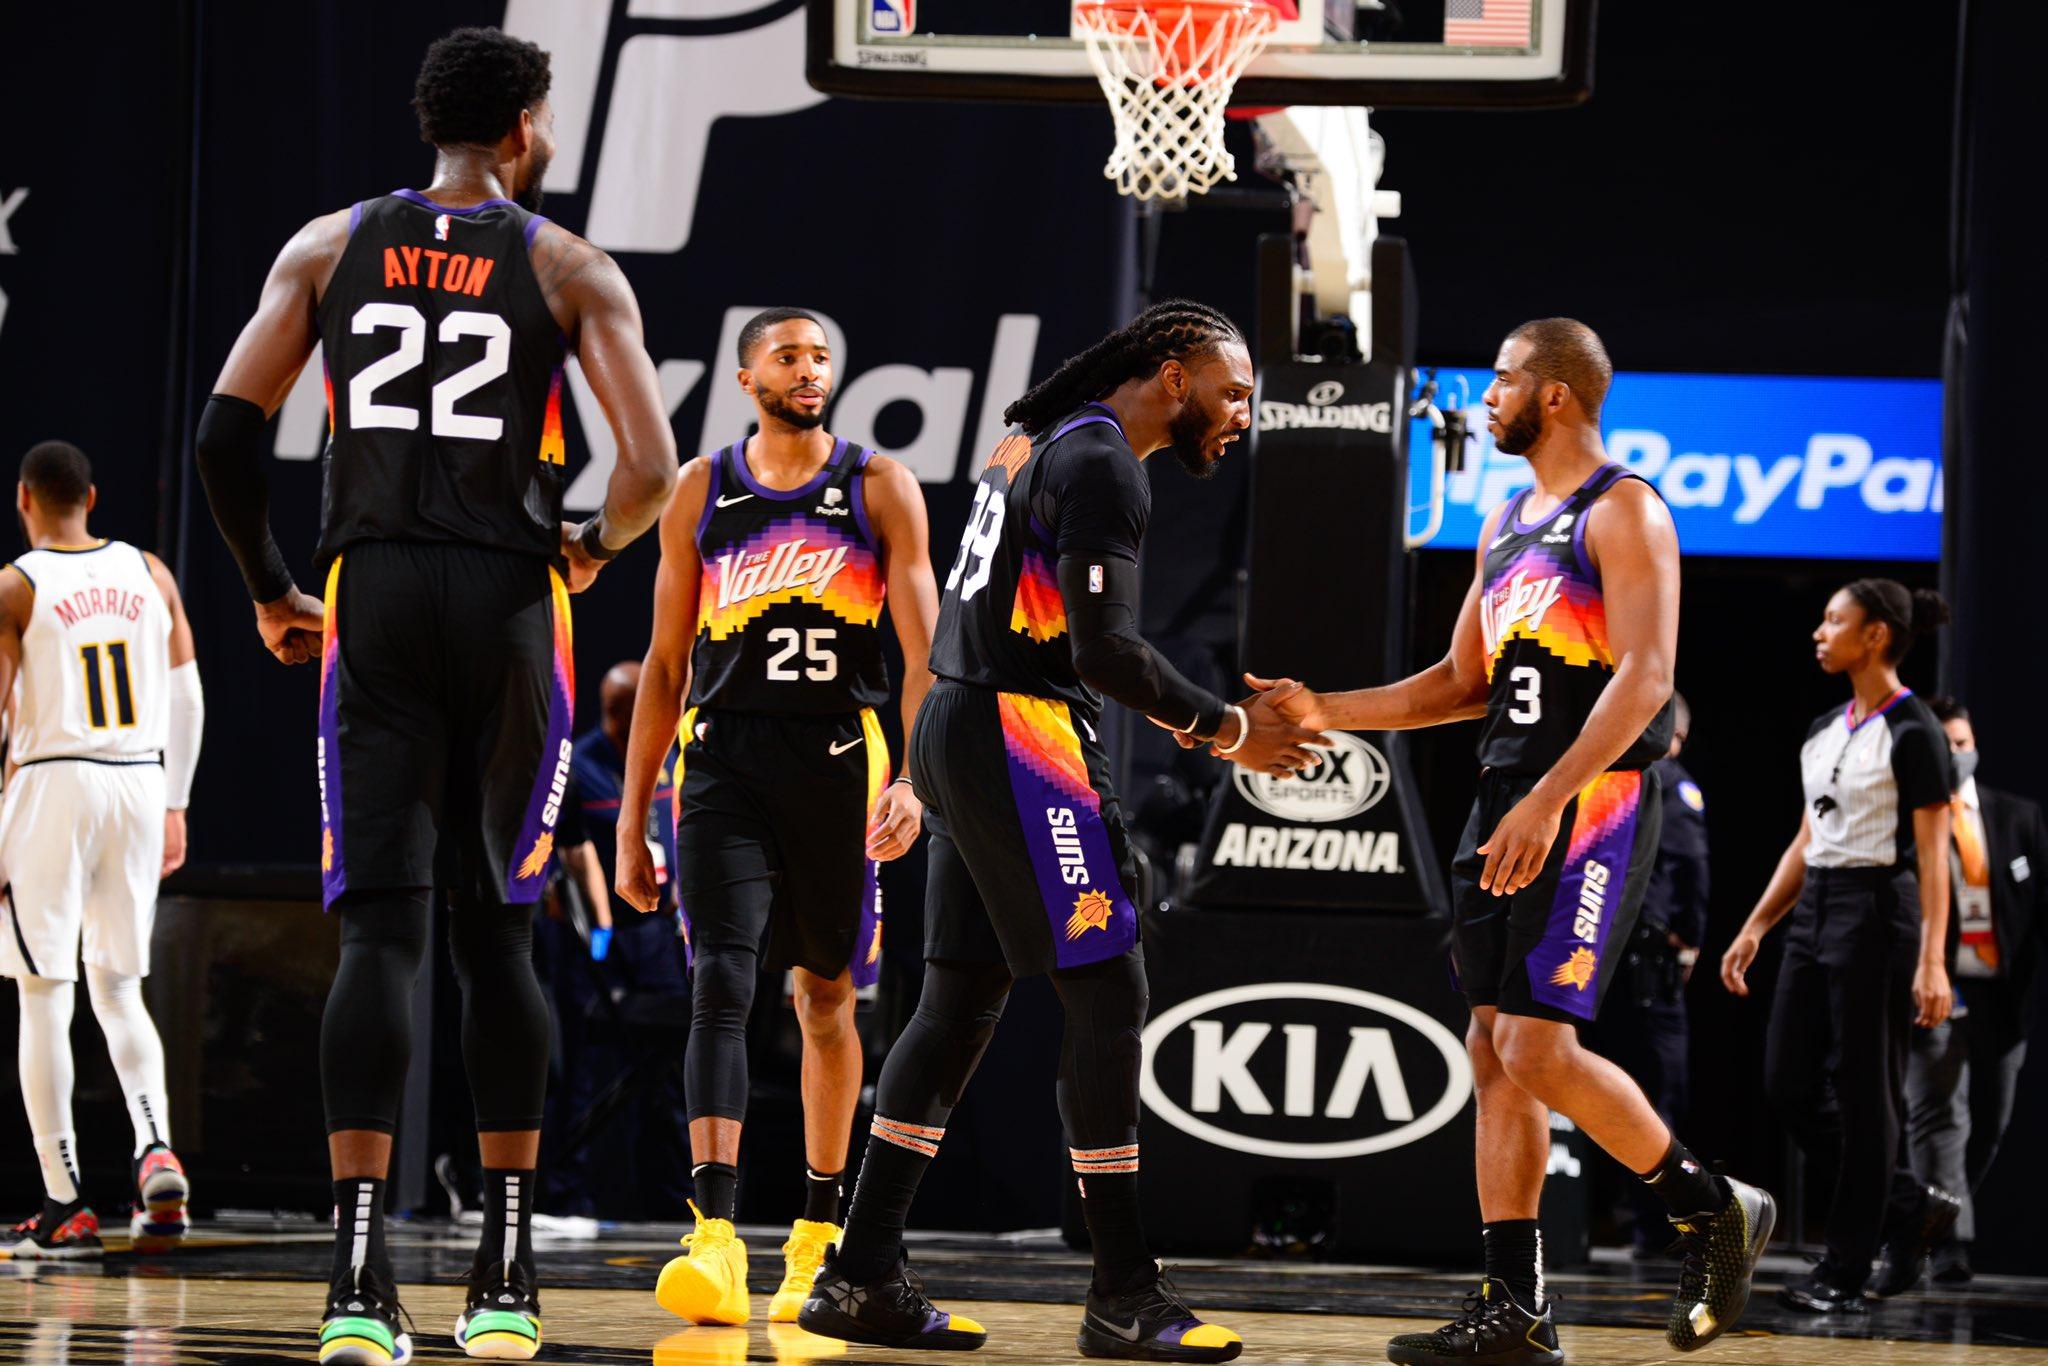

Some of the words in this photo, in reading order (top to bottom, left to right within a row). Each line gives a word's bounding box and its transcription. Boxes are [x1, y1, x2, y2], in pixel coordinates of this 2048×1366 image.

[384, 246, 495, 297] AYTON
[350, 303, 511, 440] 22
[1259, 400, 1390, 433] SPALDING
[716, 538, 849, 609] Valley
[745, 551, 771, 566] THE
[54, 587, 145, 630] MORRIS
[767, 627, 838, 681] 25
[78, 639, 138, 730] 11
[1508, 666, 1541, 724] 3
[1268, 785, 1357, 804] SPORTS
[1189, 1019, 1414, 1121] KIA
